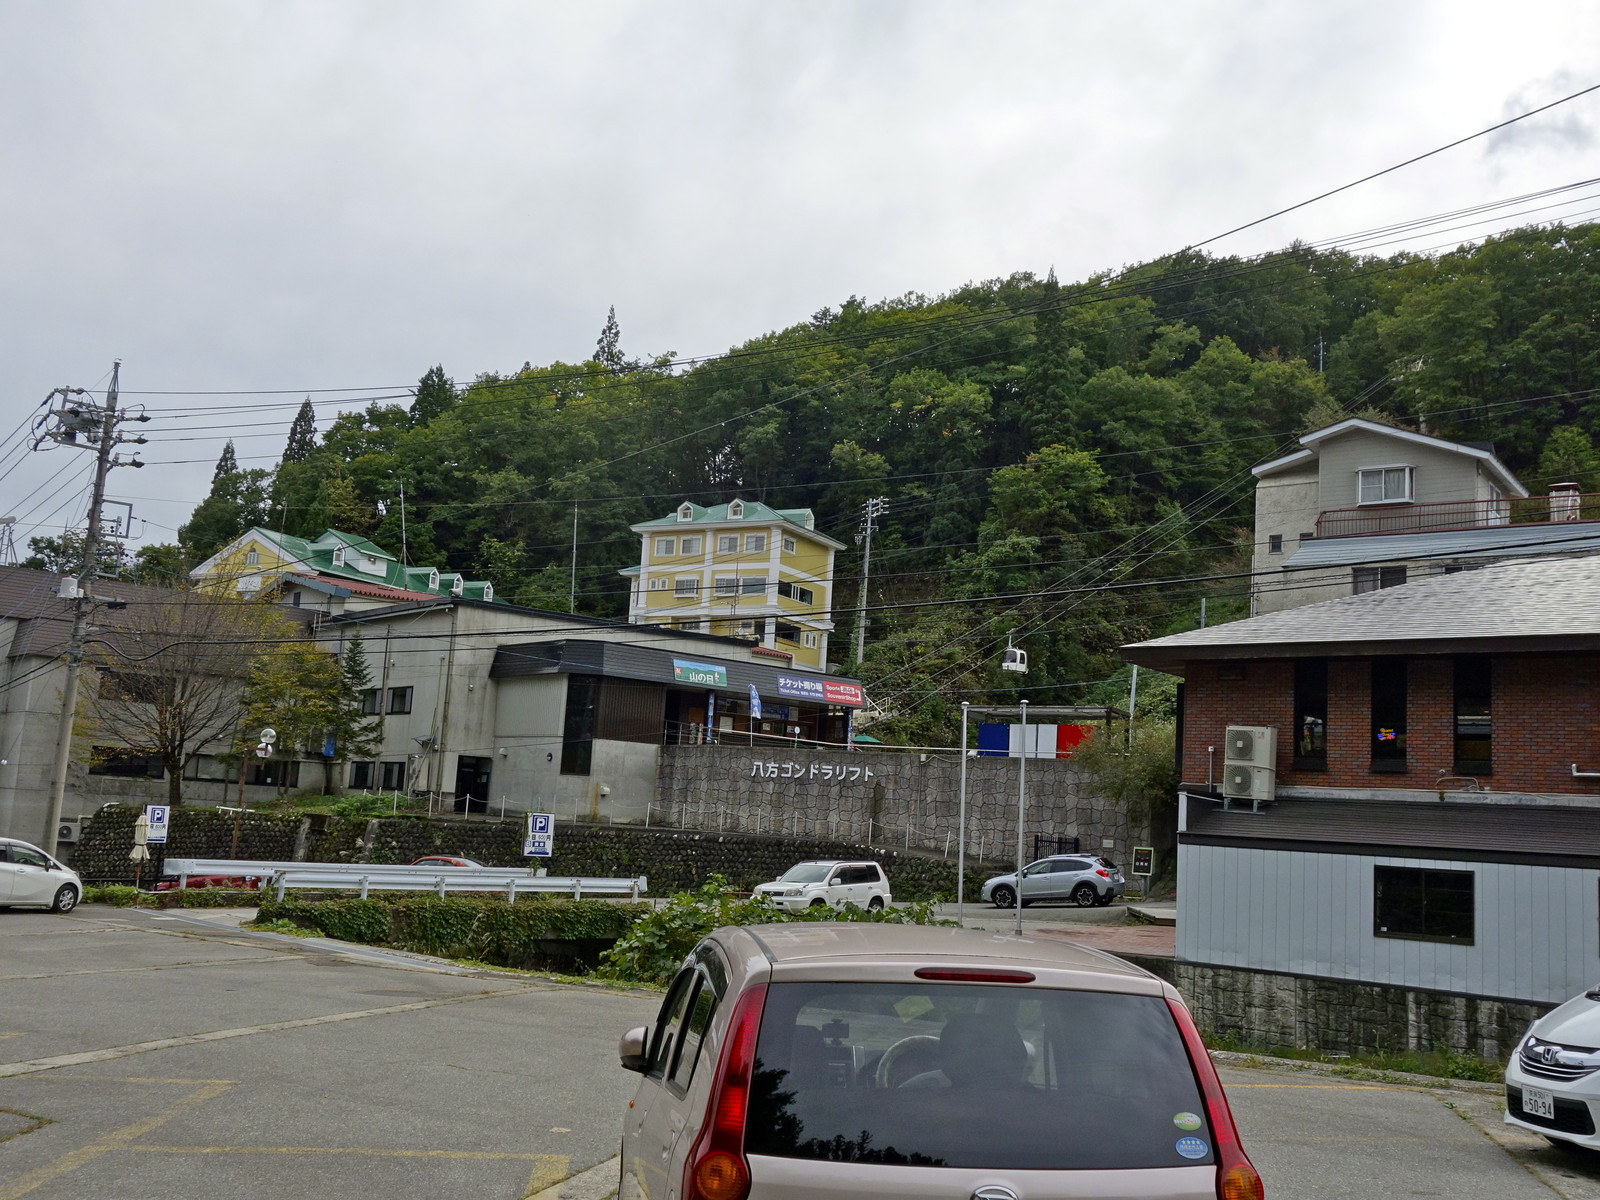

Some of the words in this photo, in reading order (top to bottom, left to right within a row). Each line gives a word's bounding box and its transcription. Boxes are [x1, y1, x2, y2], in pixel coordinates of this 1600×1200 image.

[689, 671, 714, 684] 山の日
[779, 678, 823, 692] チケット売り場
[751, 761, 874, 782] 八方ゴンドラリフト
[1529, 1098, 1551, 1116] 50-94
